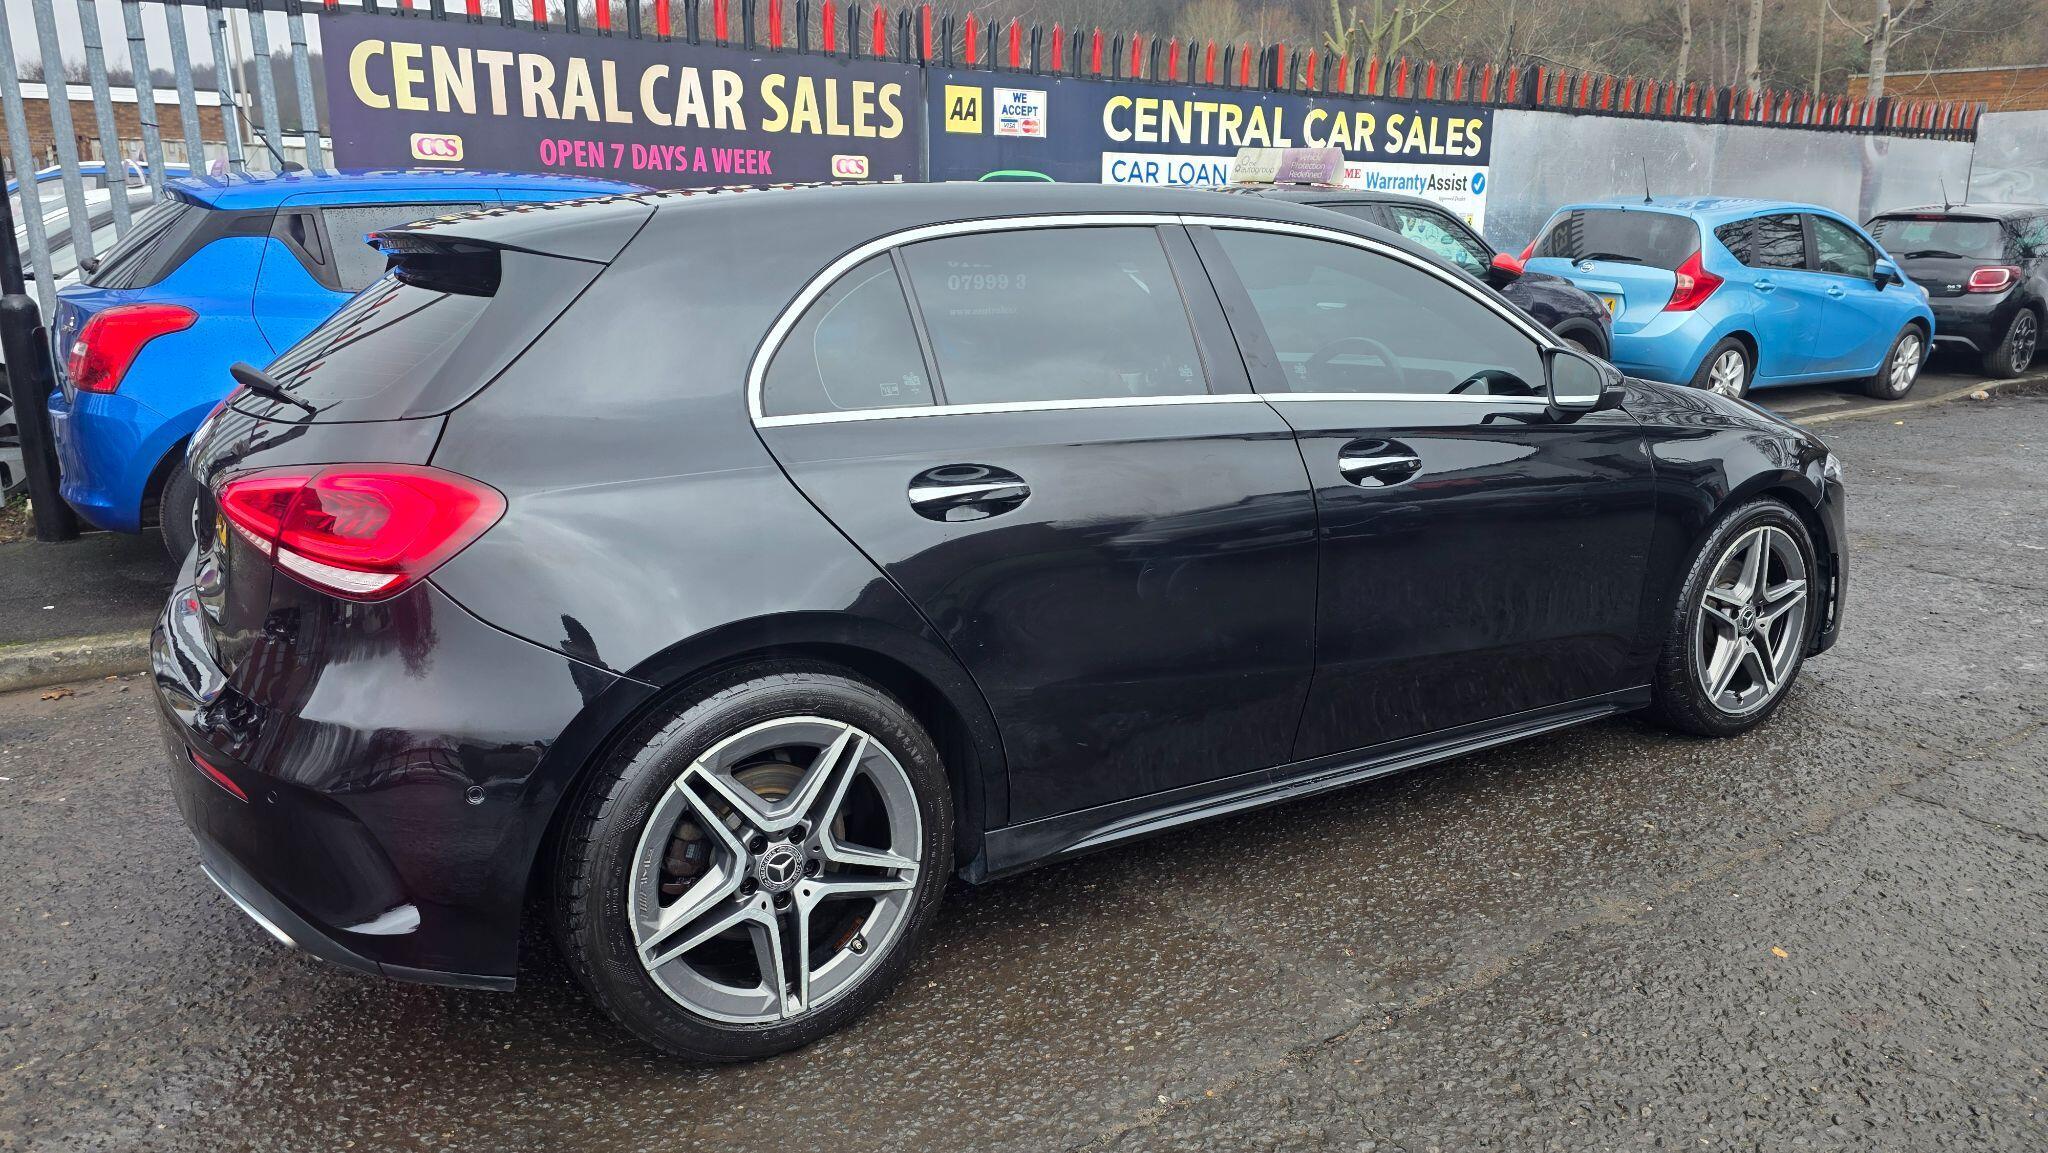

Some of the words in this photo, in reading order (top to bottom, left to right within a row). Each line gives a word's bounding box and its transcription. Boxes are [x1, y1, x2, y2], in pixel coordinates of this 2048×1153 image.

[349, 39, 633, 124] CENTRAL
[640, 64, 747, 131] CAR
[761, 73, 904, 139] SALES
[1012, 92, 1028, 104] WE
[950, 96, 976, 121] AA
[1001, 104, 1039, 117] ACCEPT
[1103, 95, 1292, 148] CENTRAL
[1303, 108, 1375, 152] CAR
[1384, 113, 1484, 157] SALES
[416, 137, 458, 157] CCS
[540, 138, 605, 168] OPEN
[610, 143, 625, 169] 7
[632, 143, 687, 172] DAYS
[693, 147, 708, 172] A
[712, 147, 773, 175] WEEK
[836, 158, 865, 174] CCS
[1111, 159, 1159, 183] CAR
[1167, 162, 1227, 186] LOAN
[1290, 161, 1326, 170] Protection
[947, 274, 1009, 290] 07999
